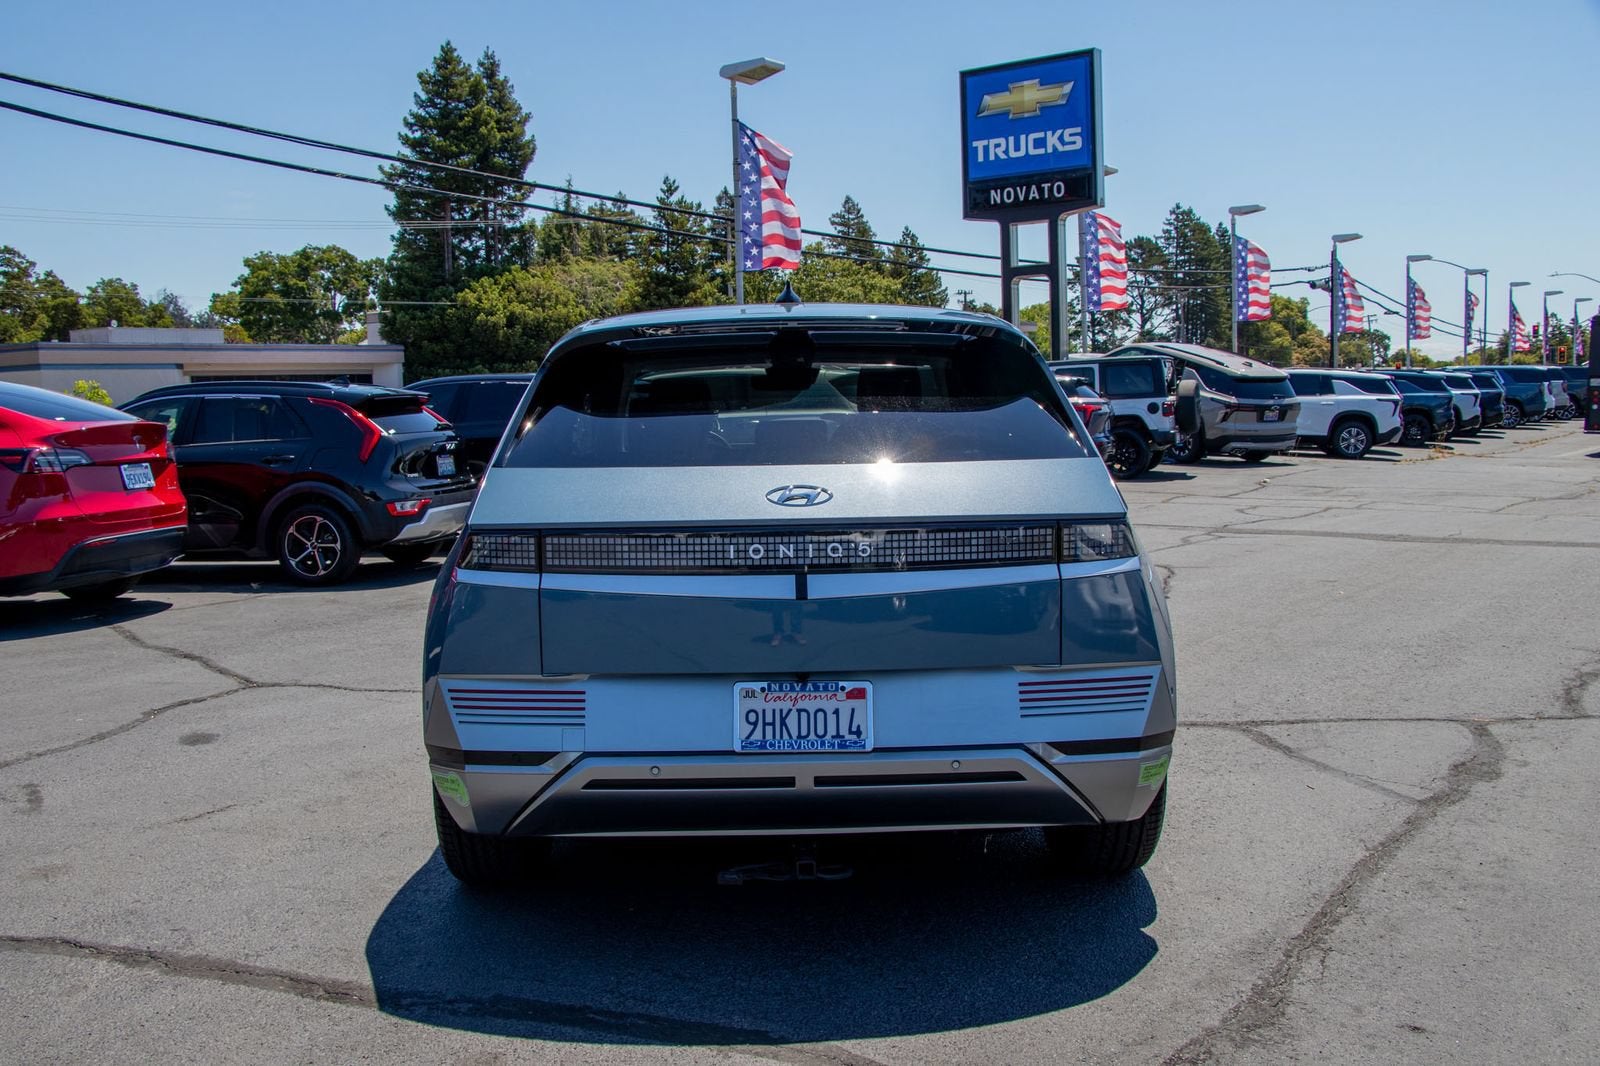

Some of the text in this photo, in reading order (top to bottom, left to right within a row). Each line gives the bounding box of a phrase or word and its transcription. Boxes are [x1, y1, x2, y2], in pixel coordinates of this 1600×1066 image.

[972, 126, 1082, 162] TRUCKS
[989, 181, 1065, 204] NOVATO
[729, 542, 871, 559] IONIQ 5
[743, 690, 758, 699] JUL
[770, 682, 836, 692] NOVATO
[763, 692, 846, 707] California
[745, 707, 863, 740] 9HKD014
[766, 740, 841, 750] CHEVROLET
